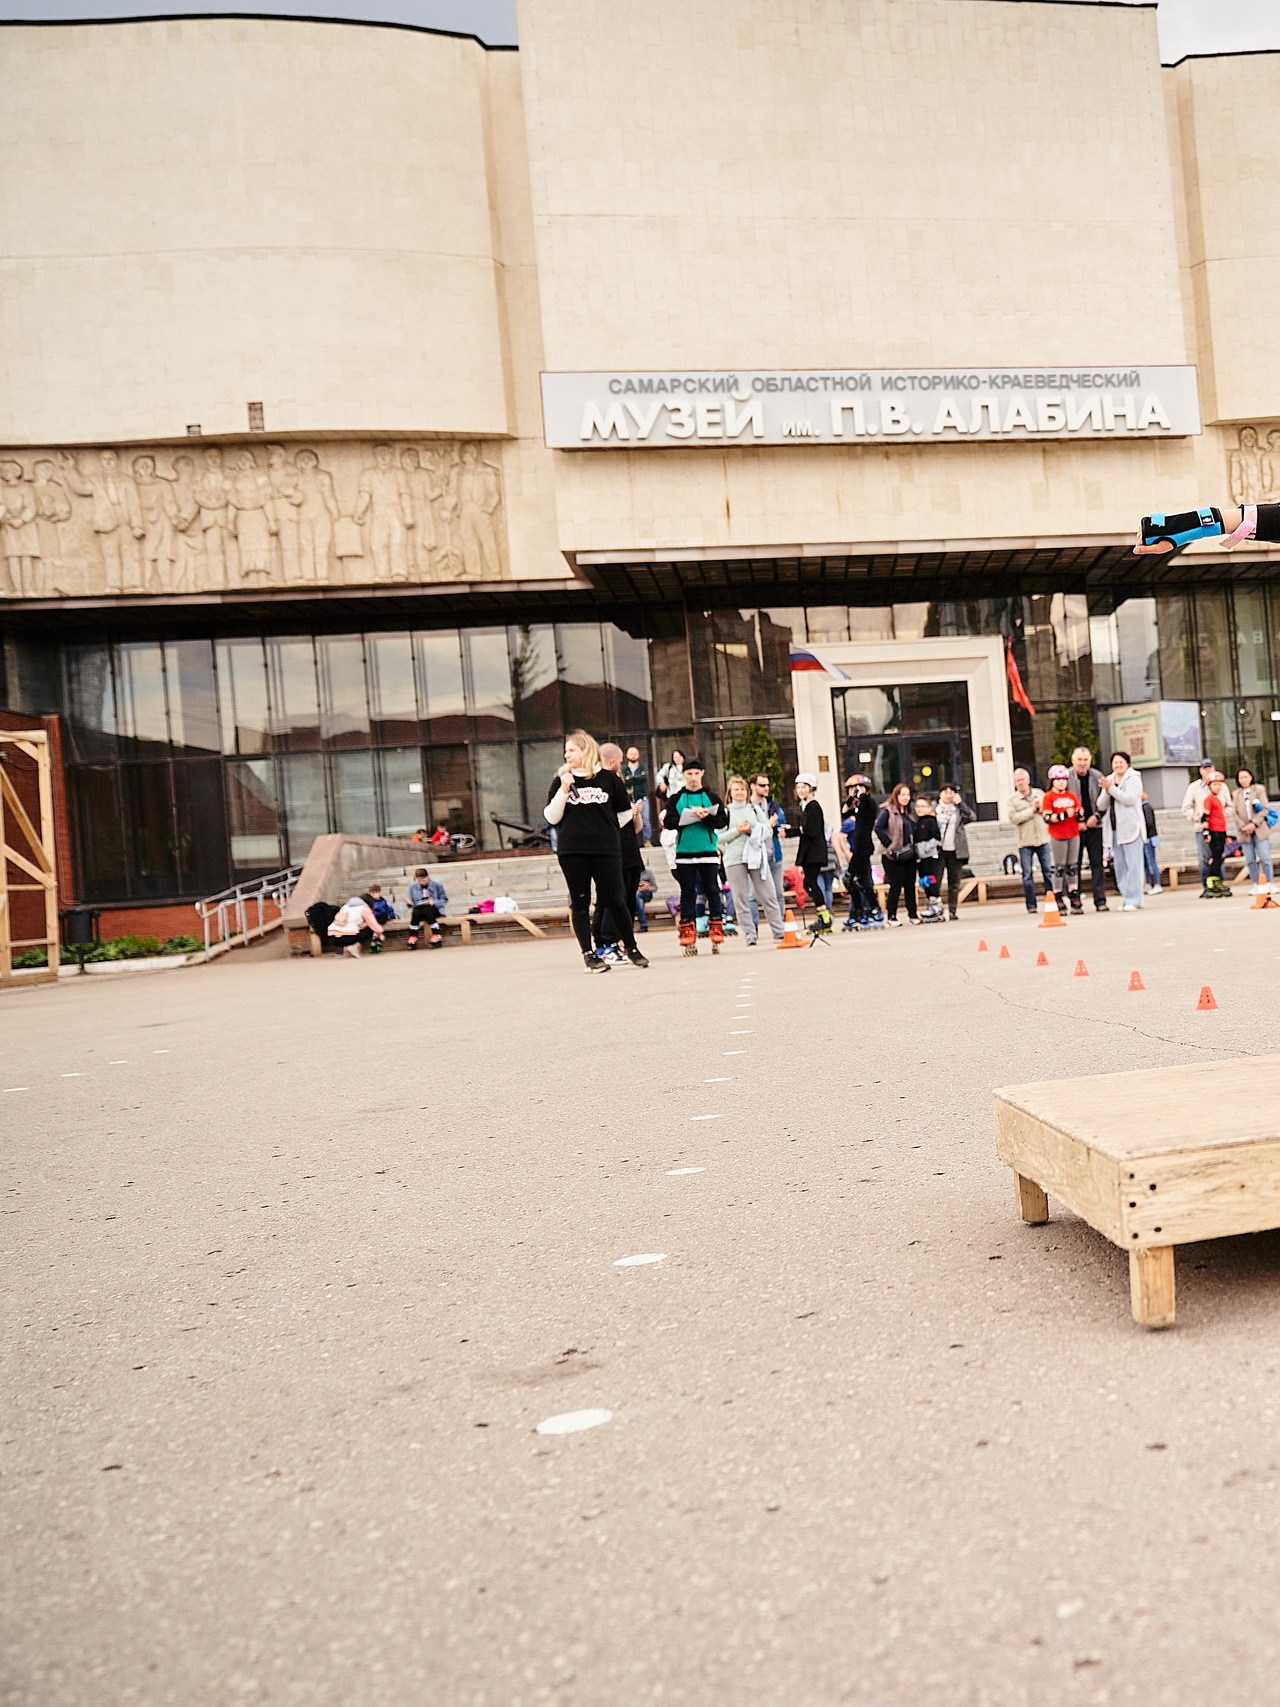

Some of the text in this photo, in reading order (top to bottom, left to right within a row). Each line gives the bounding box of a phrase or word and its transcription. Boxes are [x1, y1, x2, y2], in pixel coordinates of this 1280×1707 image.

[608, 370, 1141, 394] САМАРСКИЙ ОБЛАСТНОЙ ИСТОРИКО-КРАЕВЕДЧЕСКИЙ
[580, 390, 764, 440] МУЗЕЙ
[830, 399, 924, 436] П.В.
[931, 395, 1171, 434] АЛАБИНА
